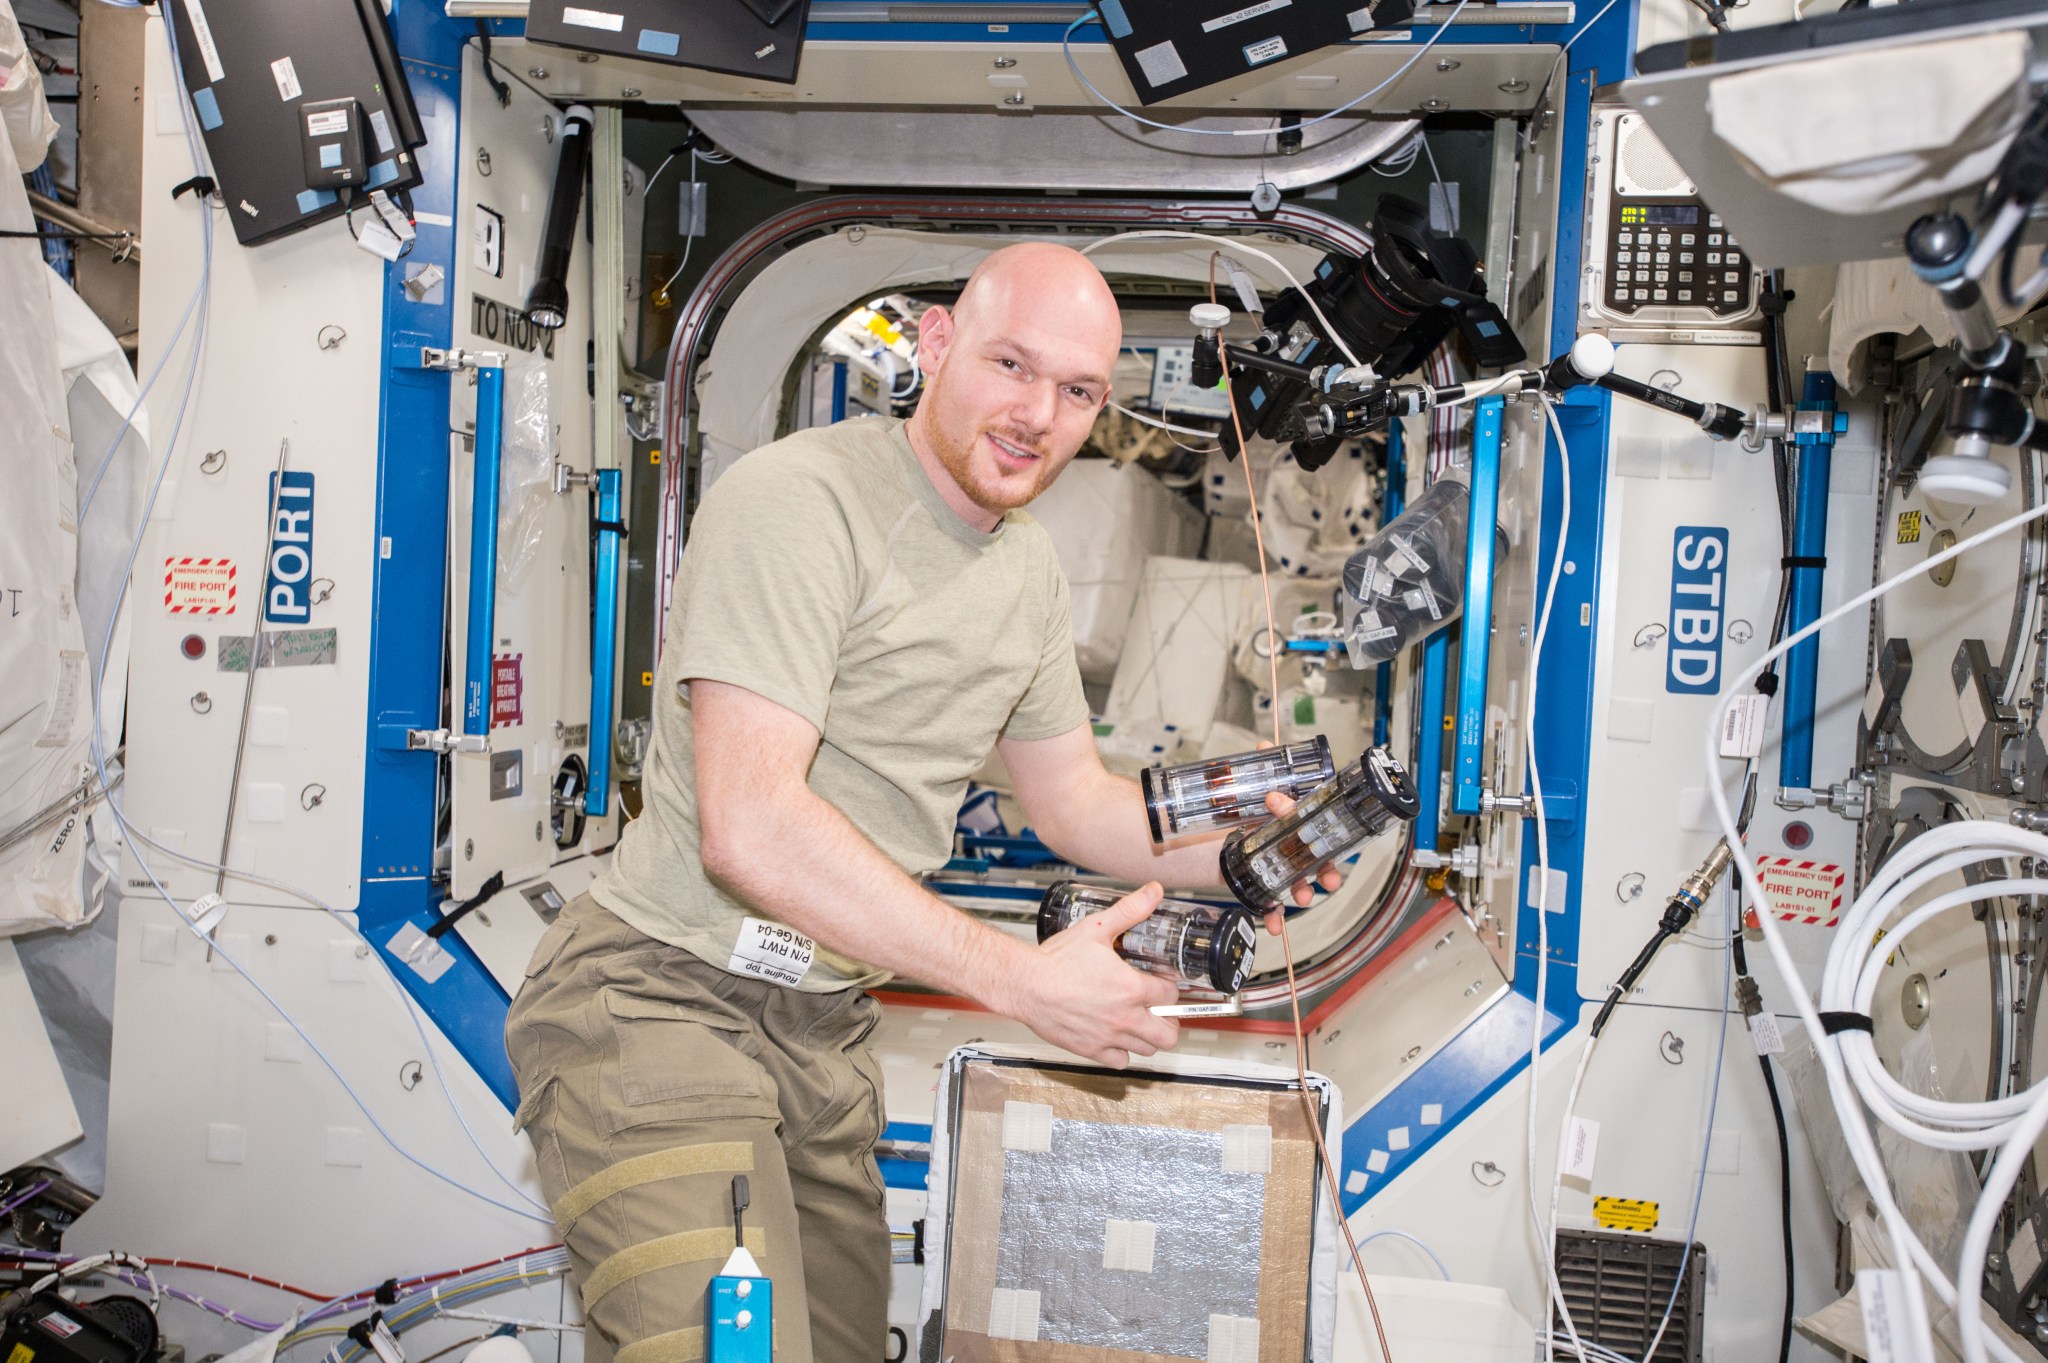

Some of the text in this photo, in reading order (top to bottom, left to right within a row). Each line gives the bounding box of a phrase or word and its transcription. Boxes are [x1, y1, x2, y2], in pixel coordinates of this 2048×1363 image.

[1244, 3, 1271, 17] SERVER
[475, 296, 498, 340] TO
[175, 581, 227, 591] FIRE PORT
[1671, 535, 1724, 686] STBD
[497, 668, 516, 682] PORTABLE
[496, 683, 516, 698] BREATHING
[496, 699, 517, 714] APPARATUS
[50, 818, 75, 854] ZERO
[1766, 867, 1834, 883] EMERGENCY USE
[1765, 883, 1831, 900] FIRE PORT
[1775, 902, 1816, 913] LAB1S1-01
[757, 924, 813, 951] S/N Ge-04
[758, 938, 811, 964] P/N RWT
[745, 962, 799, 984] Routine Top
[1612, 1204, 1641, 1212] WARNING
